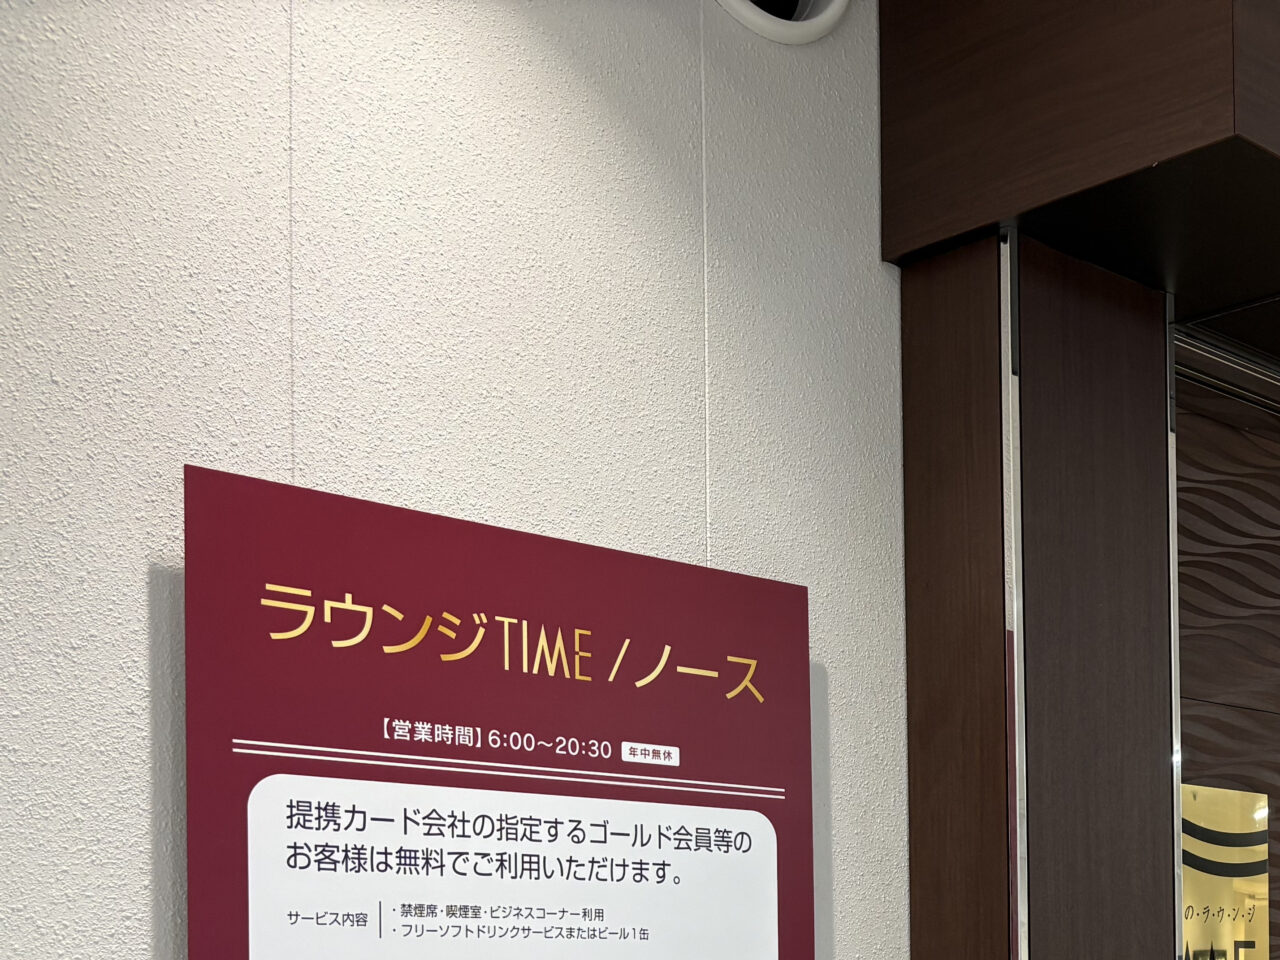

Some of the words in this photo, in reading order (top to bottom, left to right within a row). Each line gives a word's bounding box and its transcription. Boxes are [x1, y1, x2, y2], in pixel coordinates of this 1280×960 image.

[635, 645, 764, 703] ノース
[628, 746, 673, 762] 年中無休
[286, 798, 752, 854] 提携カード会社の指定するゴールド会員等の
[287, 842, 682, 886] お客様は無料でご利用いただけます。
[287, 910, 368, 928] サービス内容
